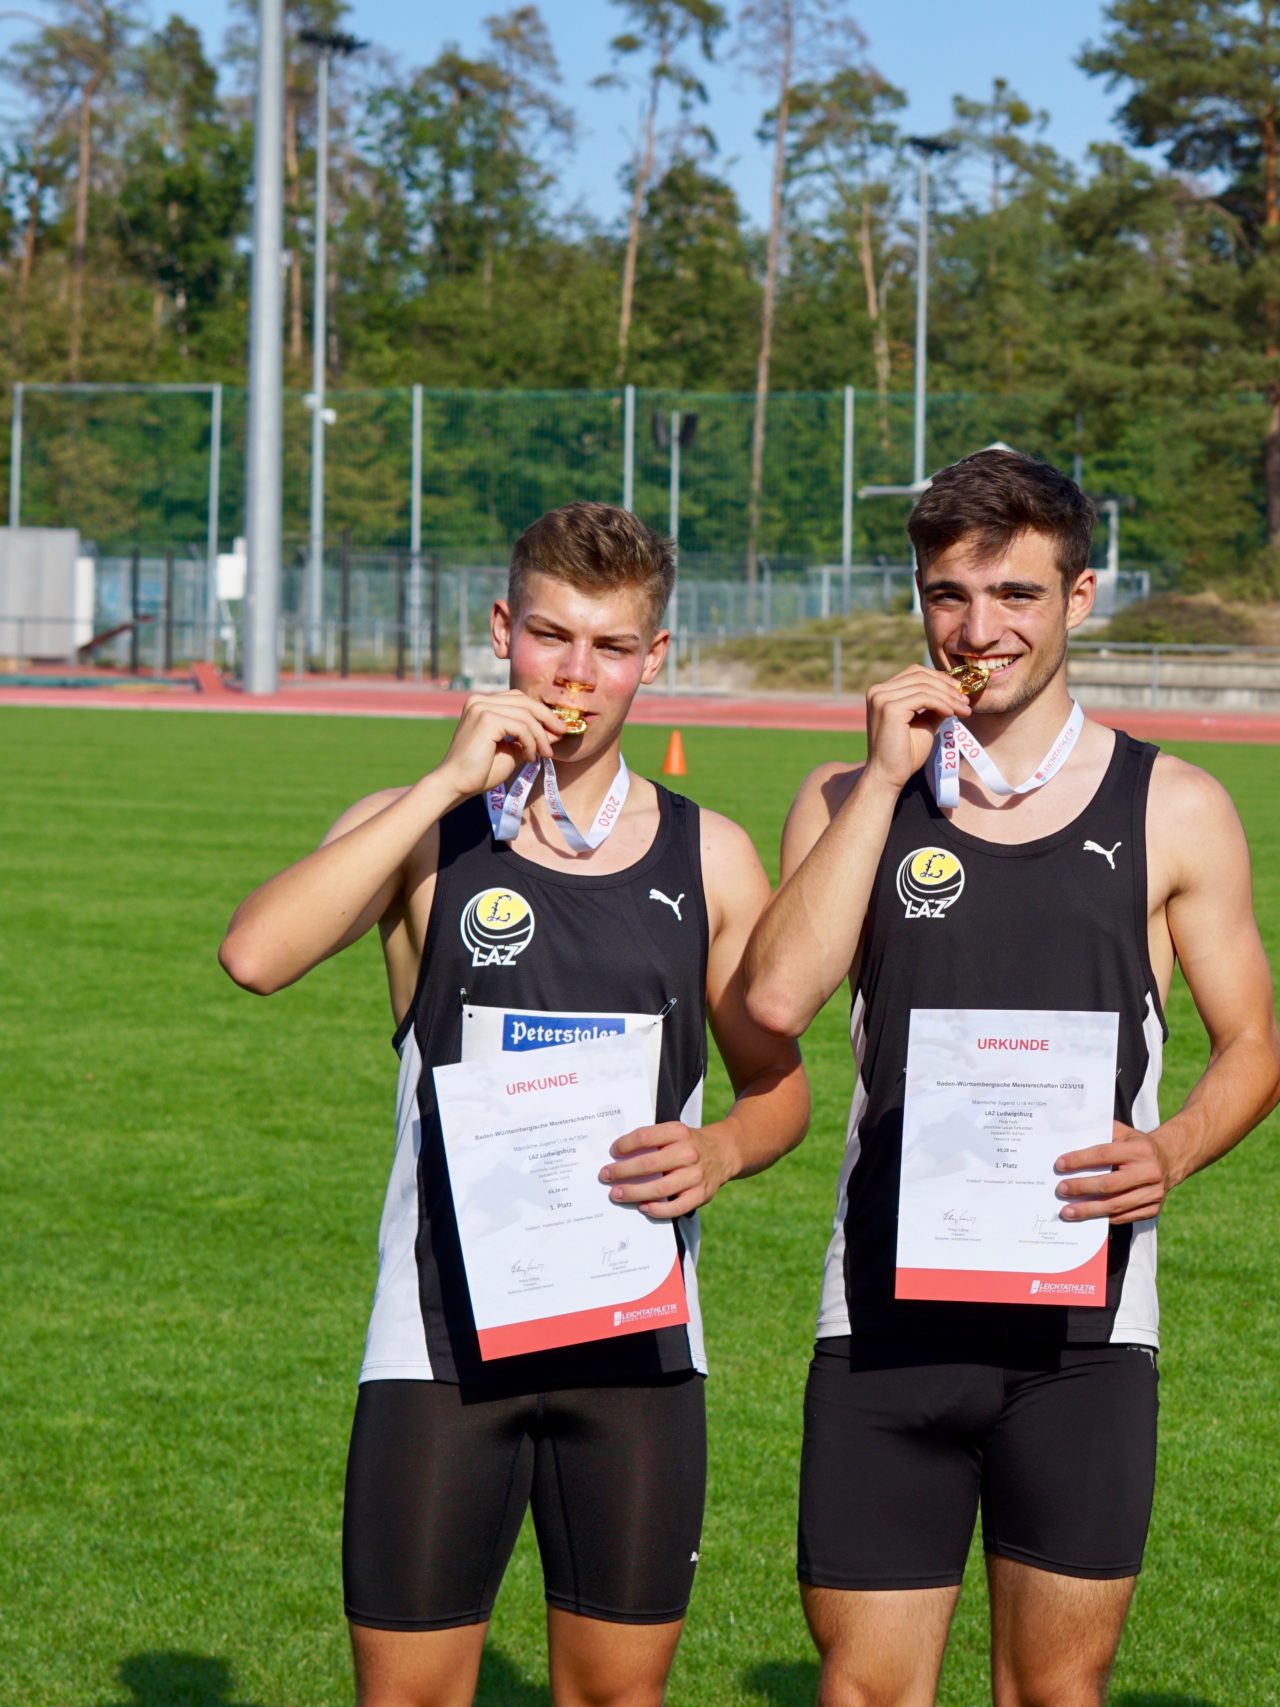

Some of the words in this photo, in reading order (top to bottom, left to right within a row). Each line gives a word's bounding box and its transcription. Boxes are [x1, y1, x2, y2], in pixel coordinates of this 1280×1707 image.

[943, 730, 956, 769] 2020
[490, 786, 504, 810] 202
[599, 796, 620, 827] 2020
[904, 899, 947, 919] LAZ
[472, 945, 519, 967] LAZ
[510, 1020, 618, 1045] Peterstaler
[977, 1038, 1049, 1051] URKUNDE
[506, 1072, 578, 1096] URKUNDE
[549, 1113, 596, 1127] Meisterschaften
[540, 1147, 576, 1159] Ludwigsburg
[1040, 1282, 1097, 1291] LEICHTATHLETIK
[622, 1303, 677, 1319] LEICHTATHLETIK
